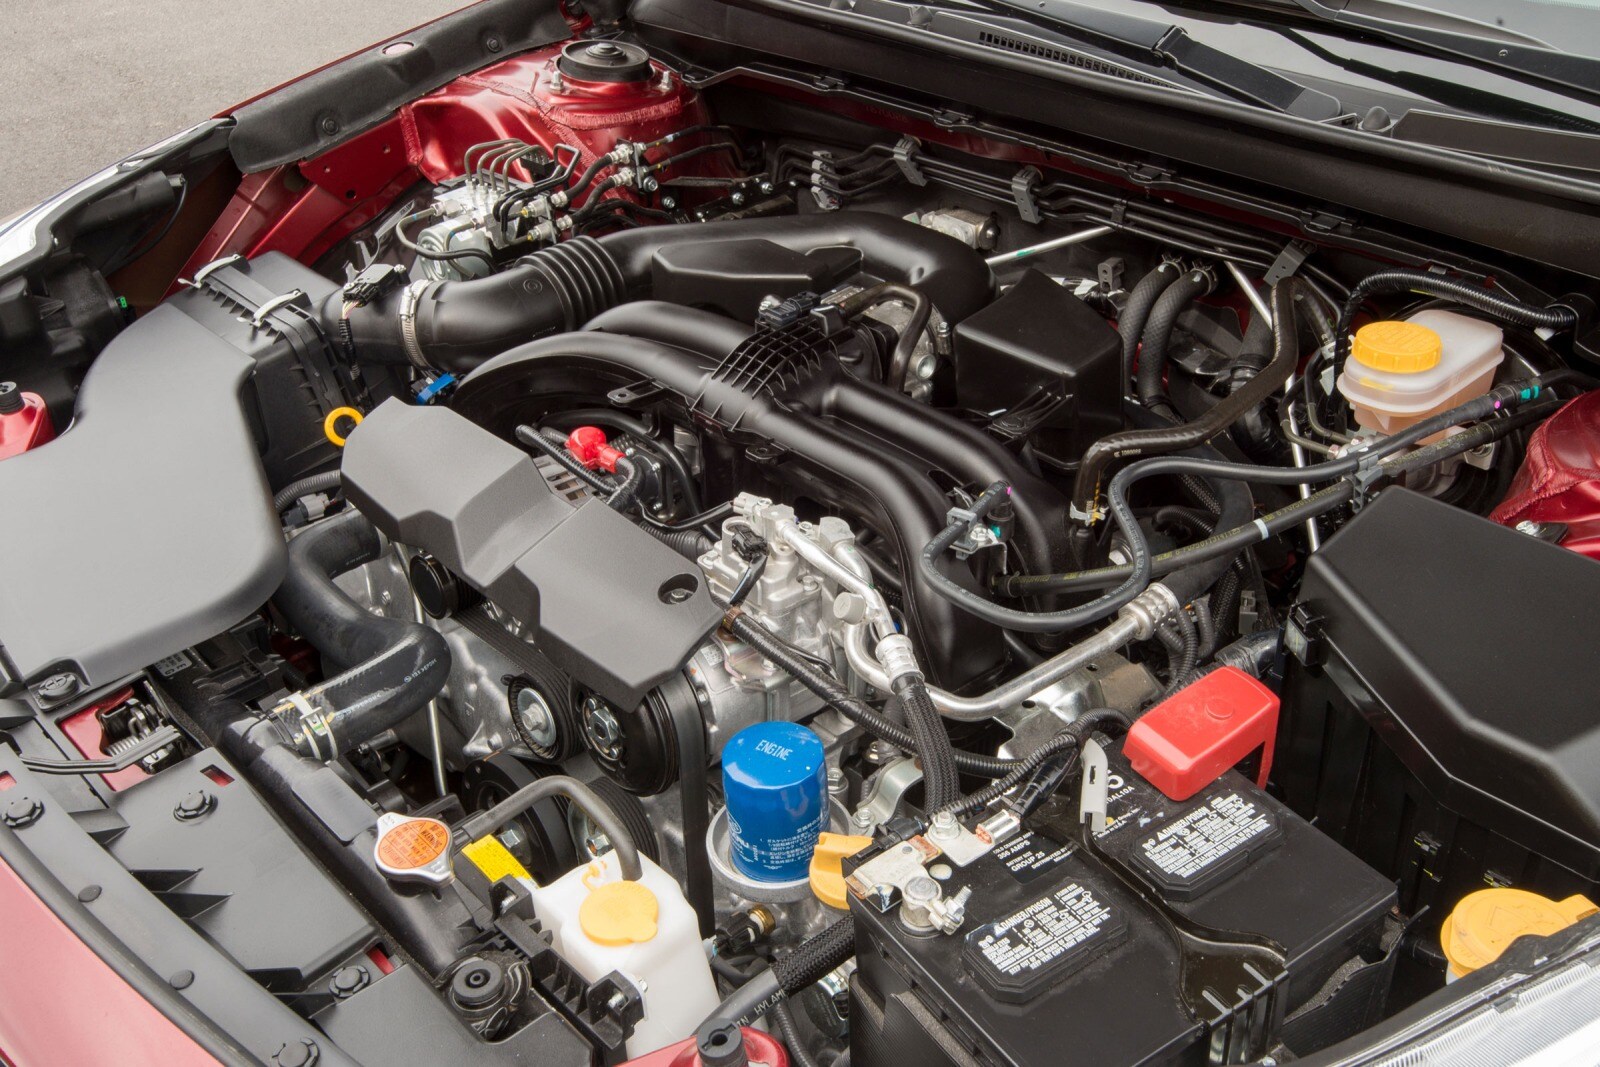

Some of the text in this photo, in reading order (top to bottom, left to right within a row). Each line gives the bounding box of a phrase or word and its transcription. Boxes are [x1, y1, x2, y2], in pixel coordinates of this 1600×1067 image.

[755, 739, 793, 761] ENGINE
[1161, 805, 1211, 837] DANGER/POISON
[1009, 838, 1030, 853] AMPS
[1011, 855, 1036, 872] GROUP
[1035, 850, 1045, 859] 25
[999, 896, 1053, 930] DANGER/POISON
